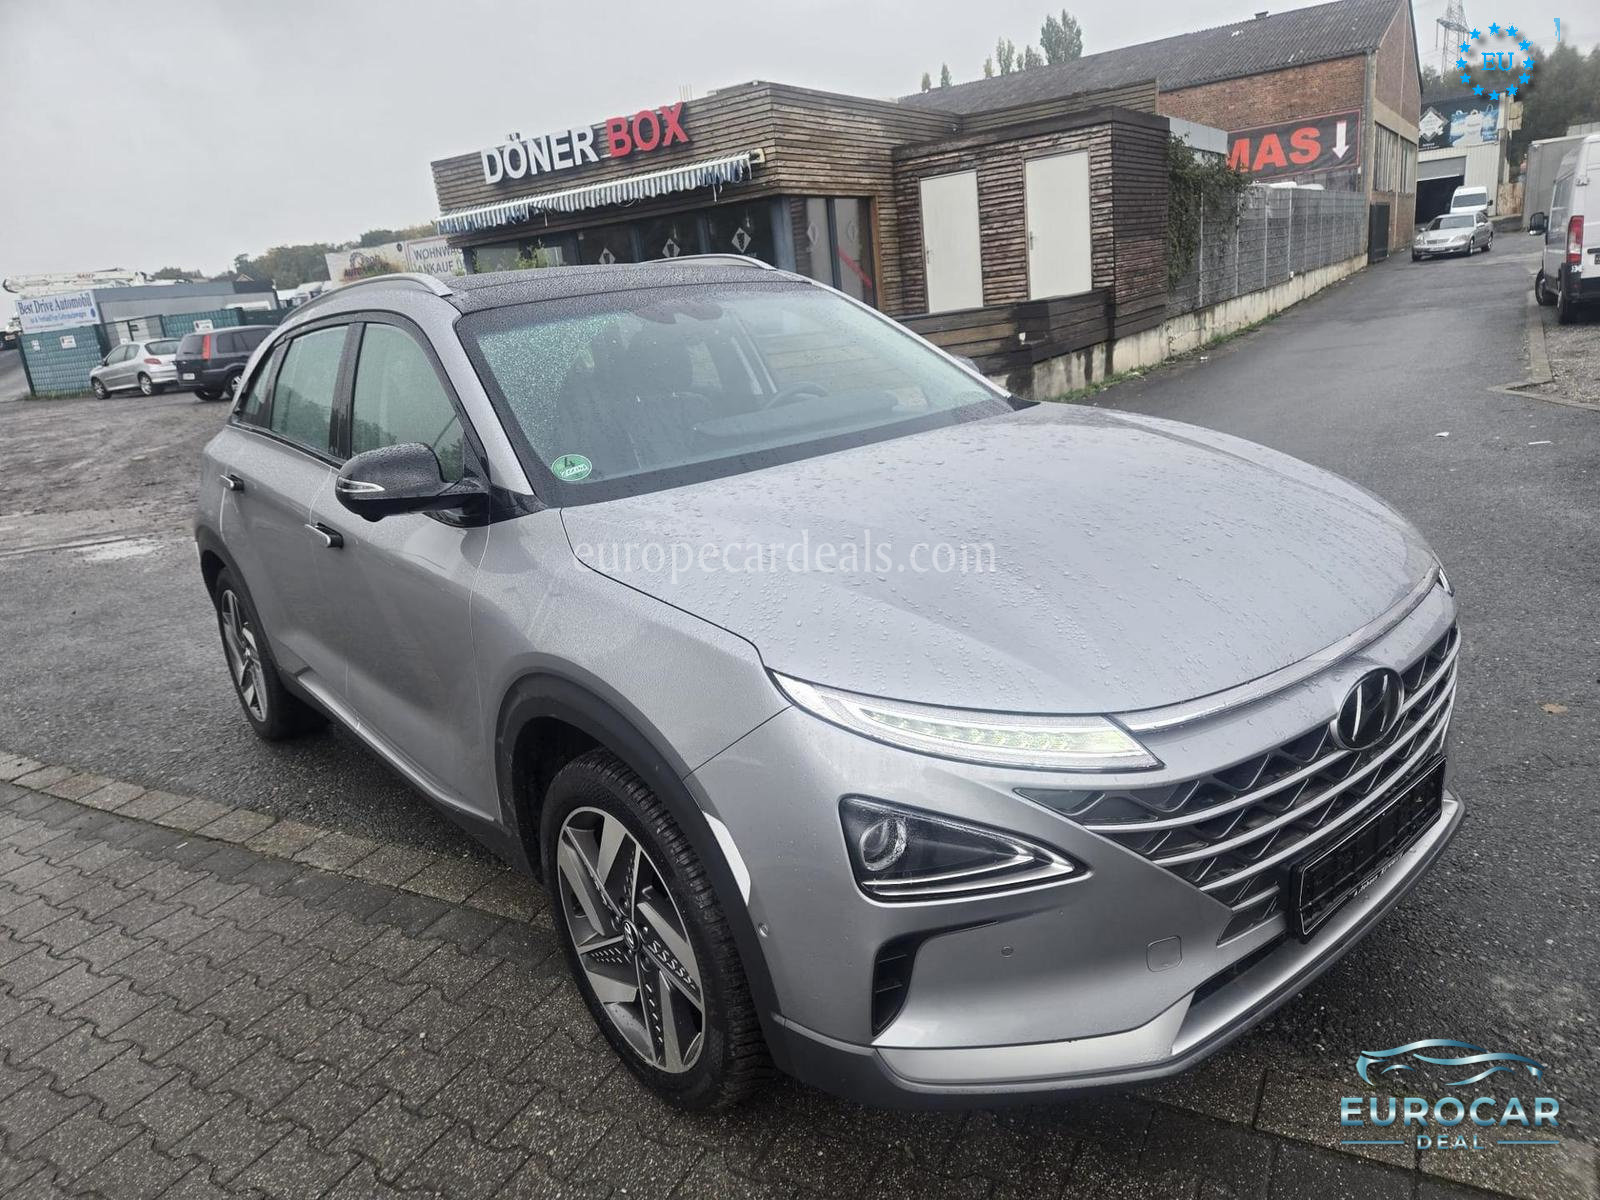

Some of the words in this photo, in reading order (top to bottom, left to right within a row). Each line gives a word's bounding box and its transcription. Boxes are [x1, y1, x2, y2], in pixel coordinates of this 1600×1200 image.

[480, 125, 600, 185] DÖNER
[605, 101, 690, 158] BOX
[17, 301, 33, 315] Best
[33, 298, 54, 313] Drive
[54, 292, 93, 311] Automobil
